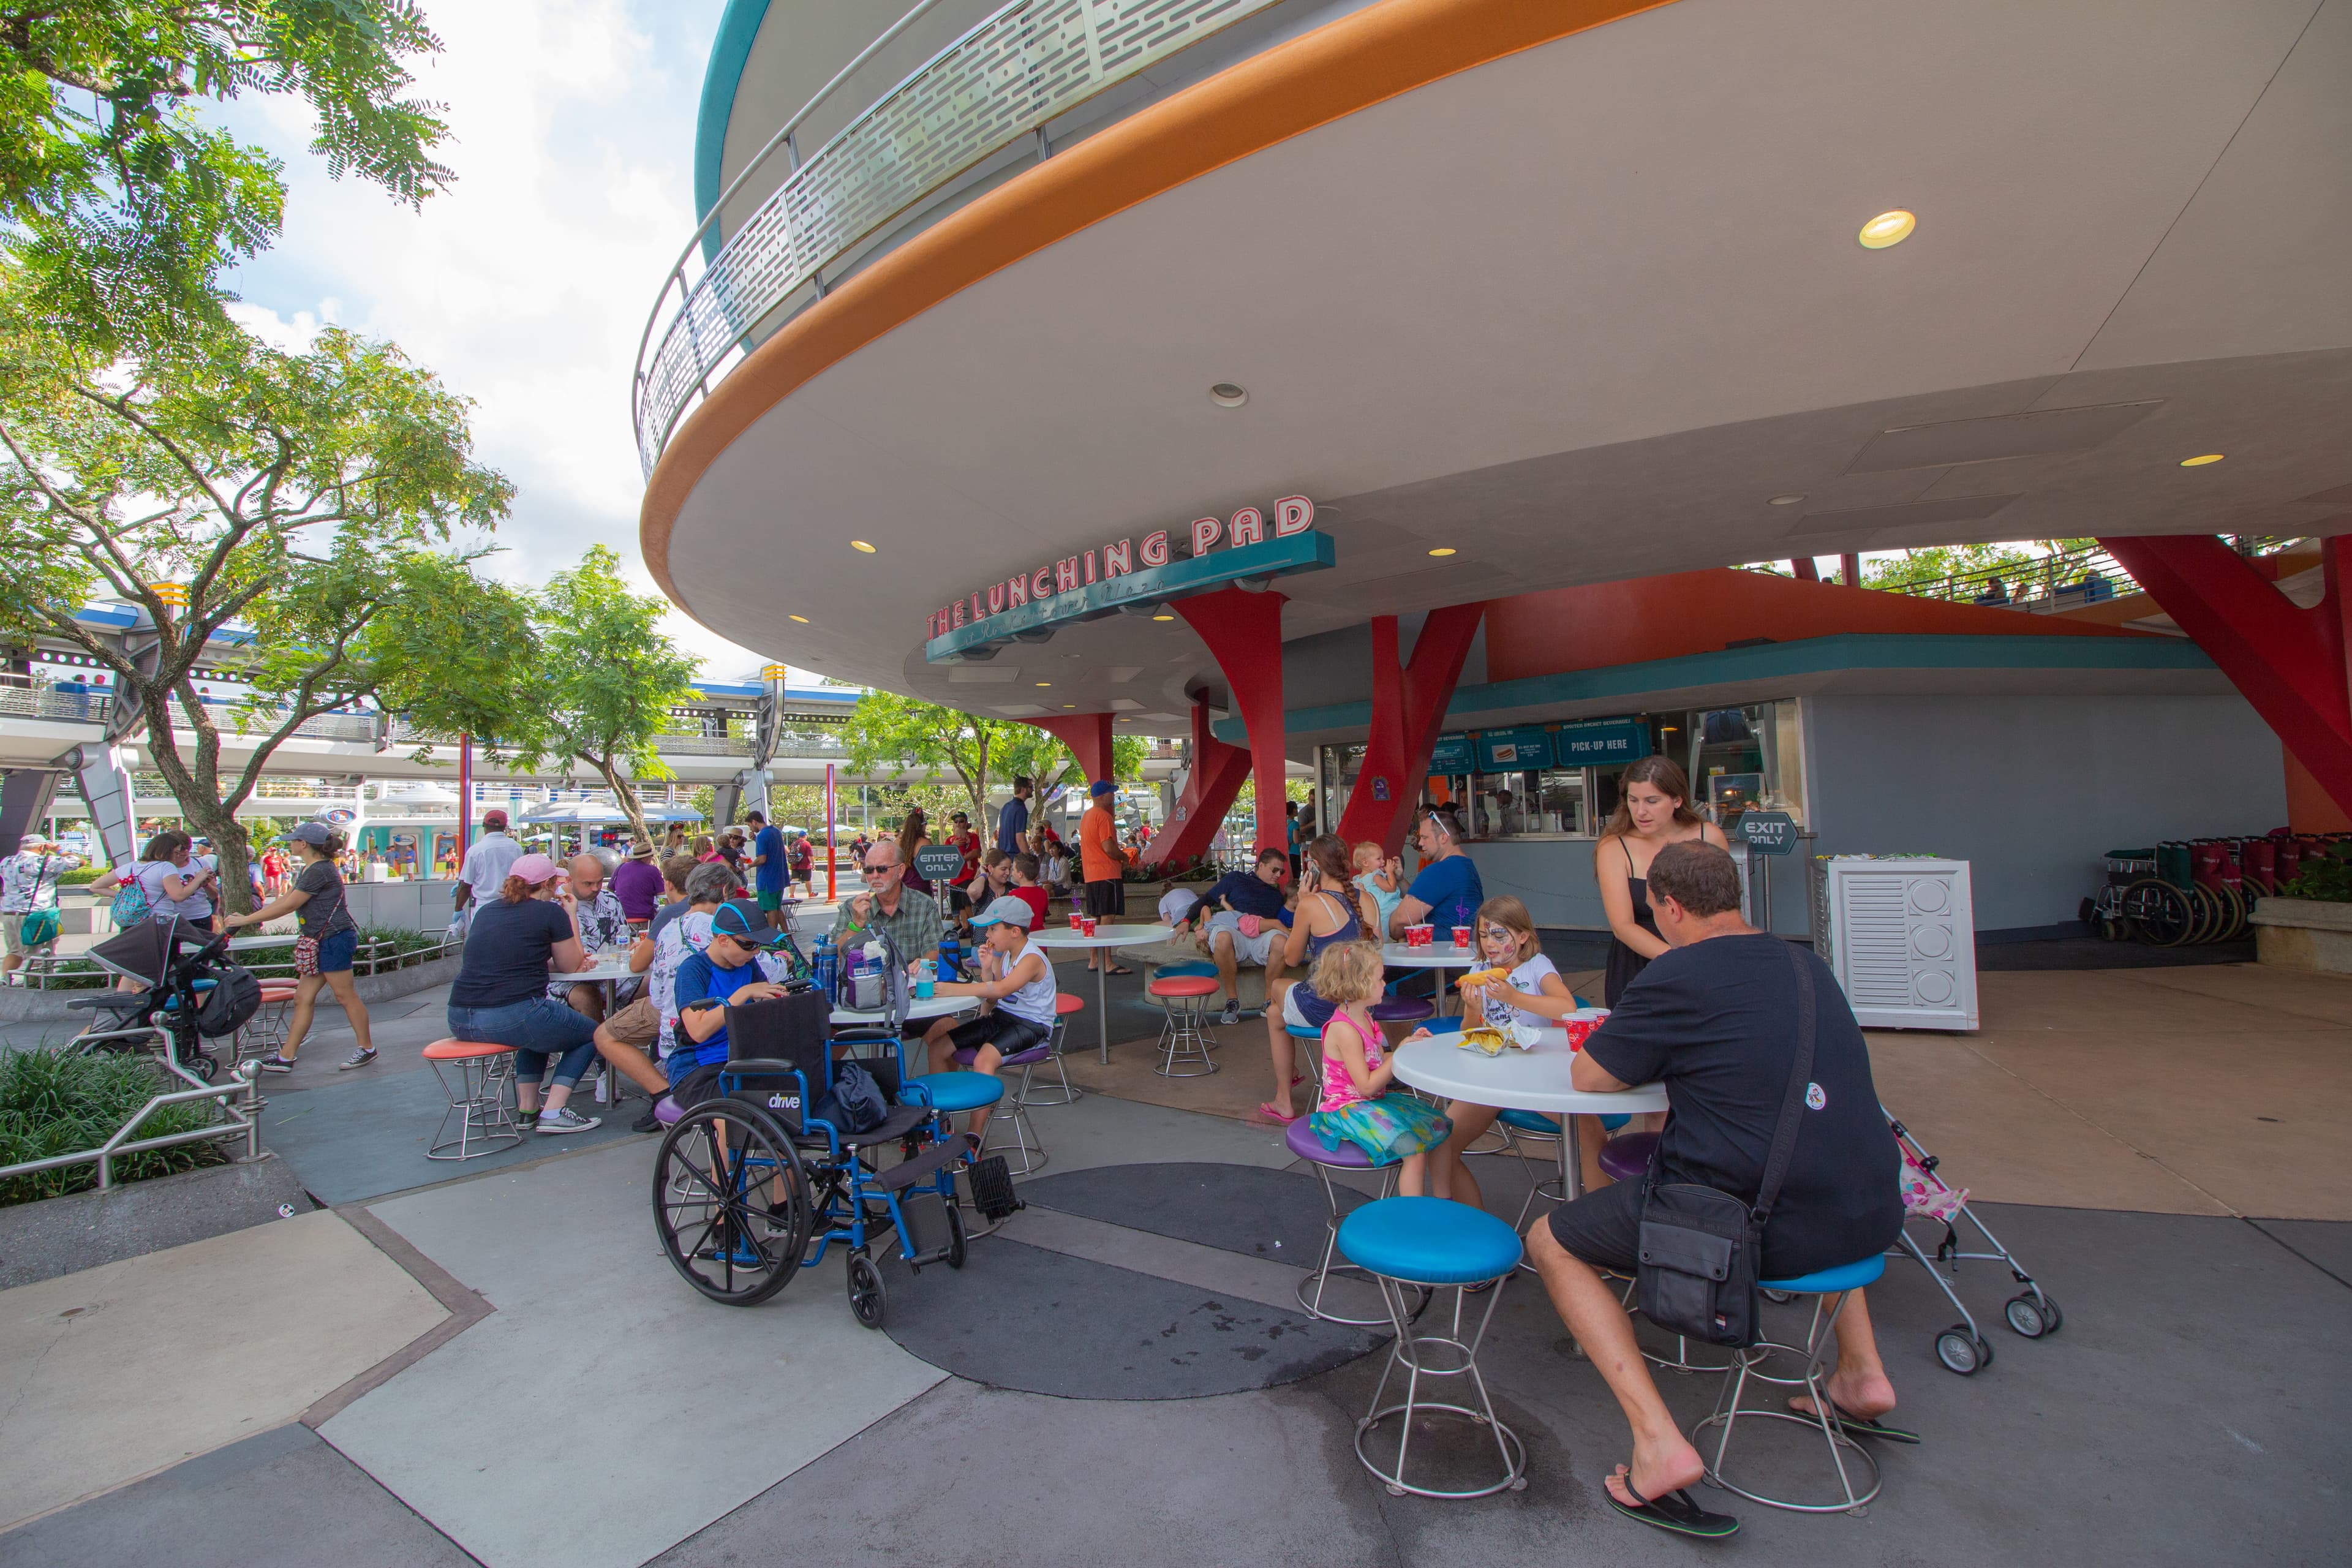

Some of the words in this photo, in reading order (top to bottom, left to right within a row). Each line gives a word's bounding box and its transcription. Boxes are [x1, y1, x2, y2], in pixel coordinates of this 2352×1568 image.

[926, 599, 966, 641] THE
[973, 530, 1169, 620] LUNCHING
[1191, 495, 1315, 557] PAD
[1571, 741, 1604, 752] PICK-UP
[1607, 739, 1627, 750] HERE
[1744, 822, 1786, 834] EXIT
[1749, 835, 1784, 845] ONLY
[920, 853, 959, 862] ENTER
[769, 1093, 800, 1109] drive
